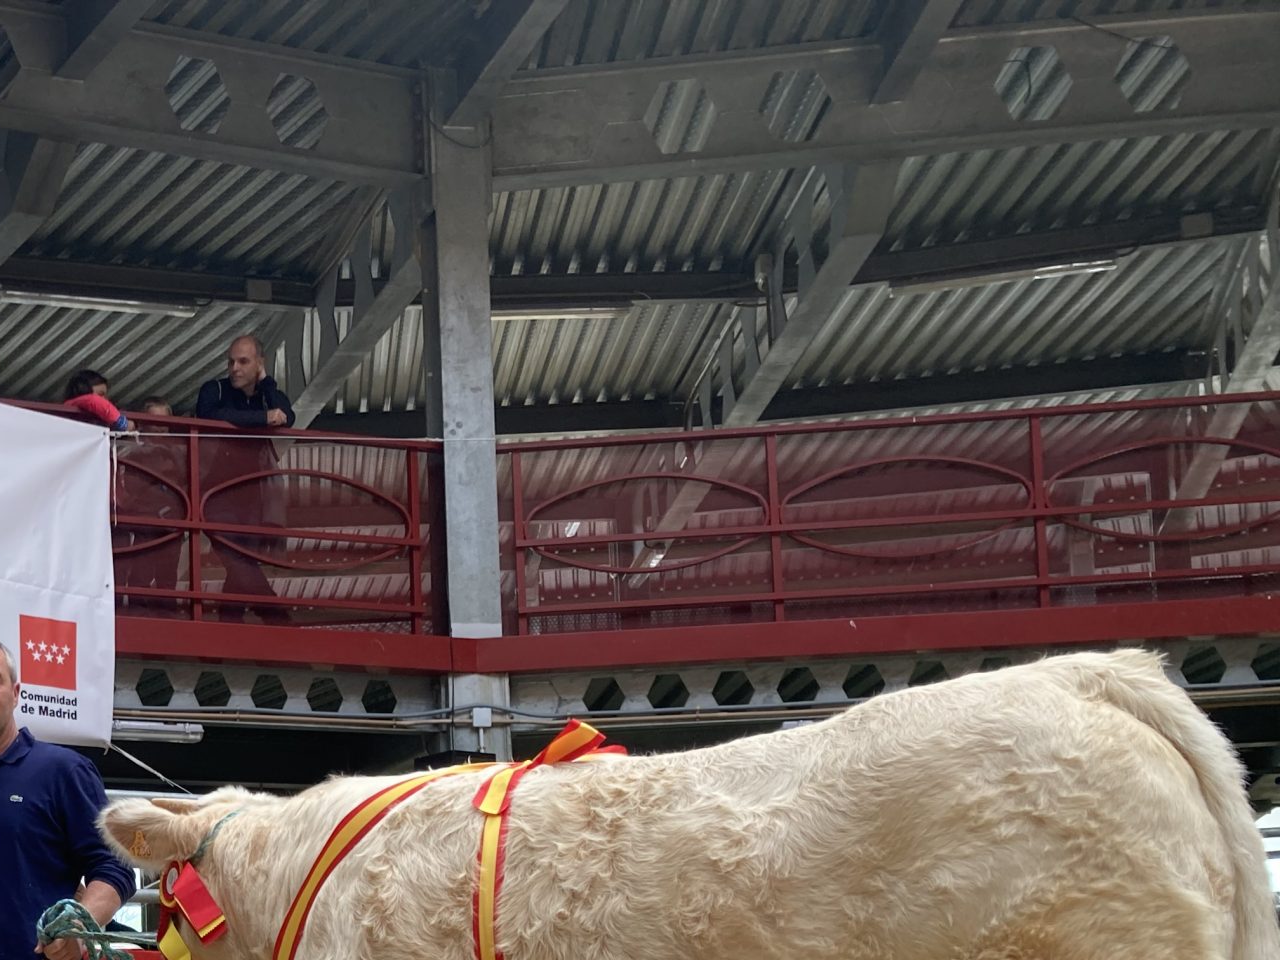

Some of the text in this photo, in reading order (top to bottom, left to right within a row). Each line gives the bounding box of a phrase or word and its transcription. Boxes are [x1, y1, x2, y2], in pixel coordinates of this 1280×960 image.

[20, 690, 78, 707] Comunidad
[21, 703, 78, 721] de Madrid
